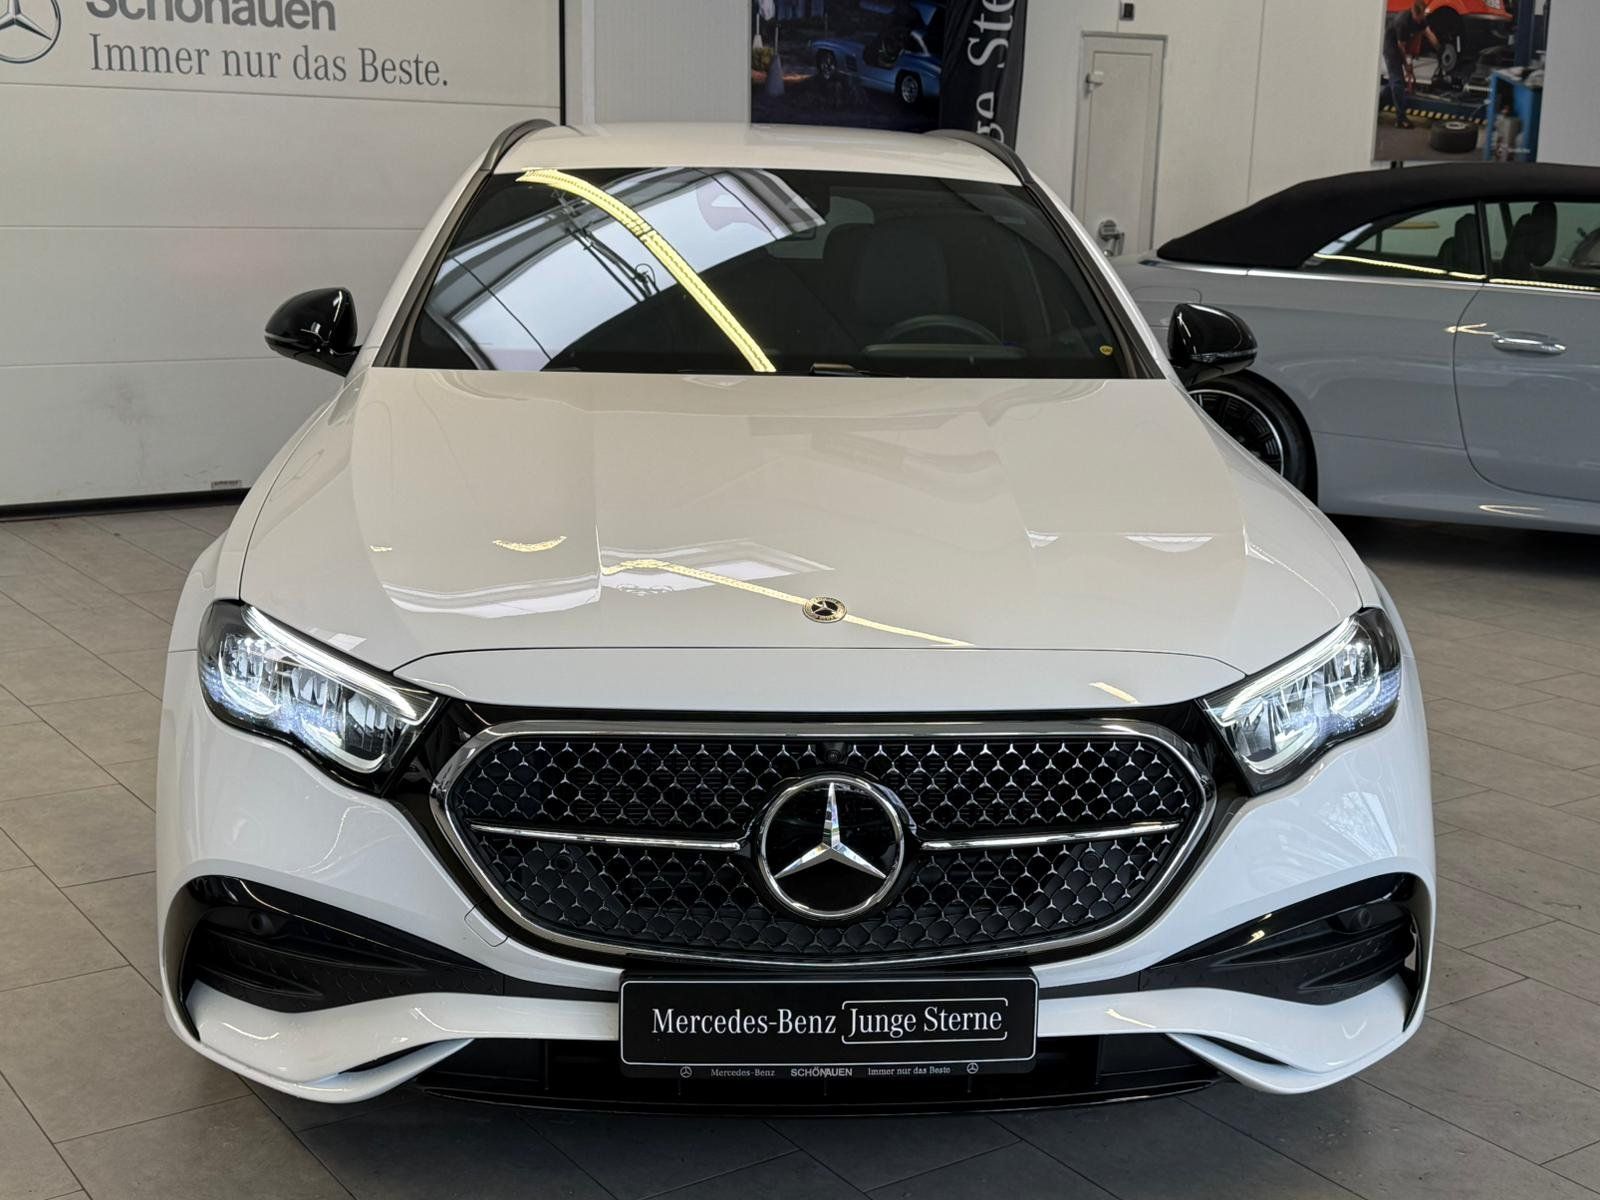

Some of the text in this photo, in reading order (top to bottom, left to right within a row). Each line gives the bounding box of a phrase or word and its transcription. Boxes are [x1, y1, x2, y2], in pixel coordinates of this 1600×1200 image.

[89, 33, 448, 86] Immer nur das Beste.
[652, 1006, 1002, 1038] Mercedes-Benz Junge Sterne
[711, 1065, 951, 1077] Mercedes-Benz SCHÖNAUEN Immer nur das Beste
